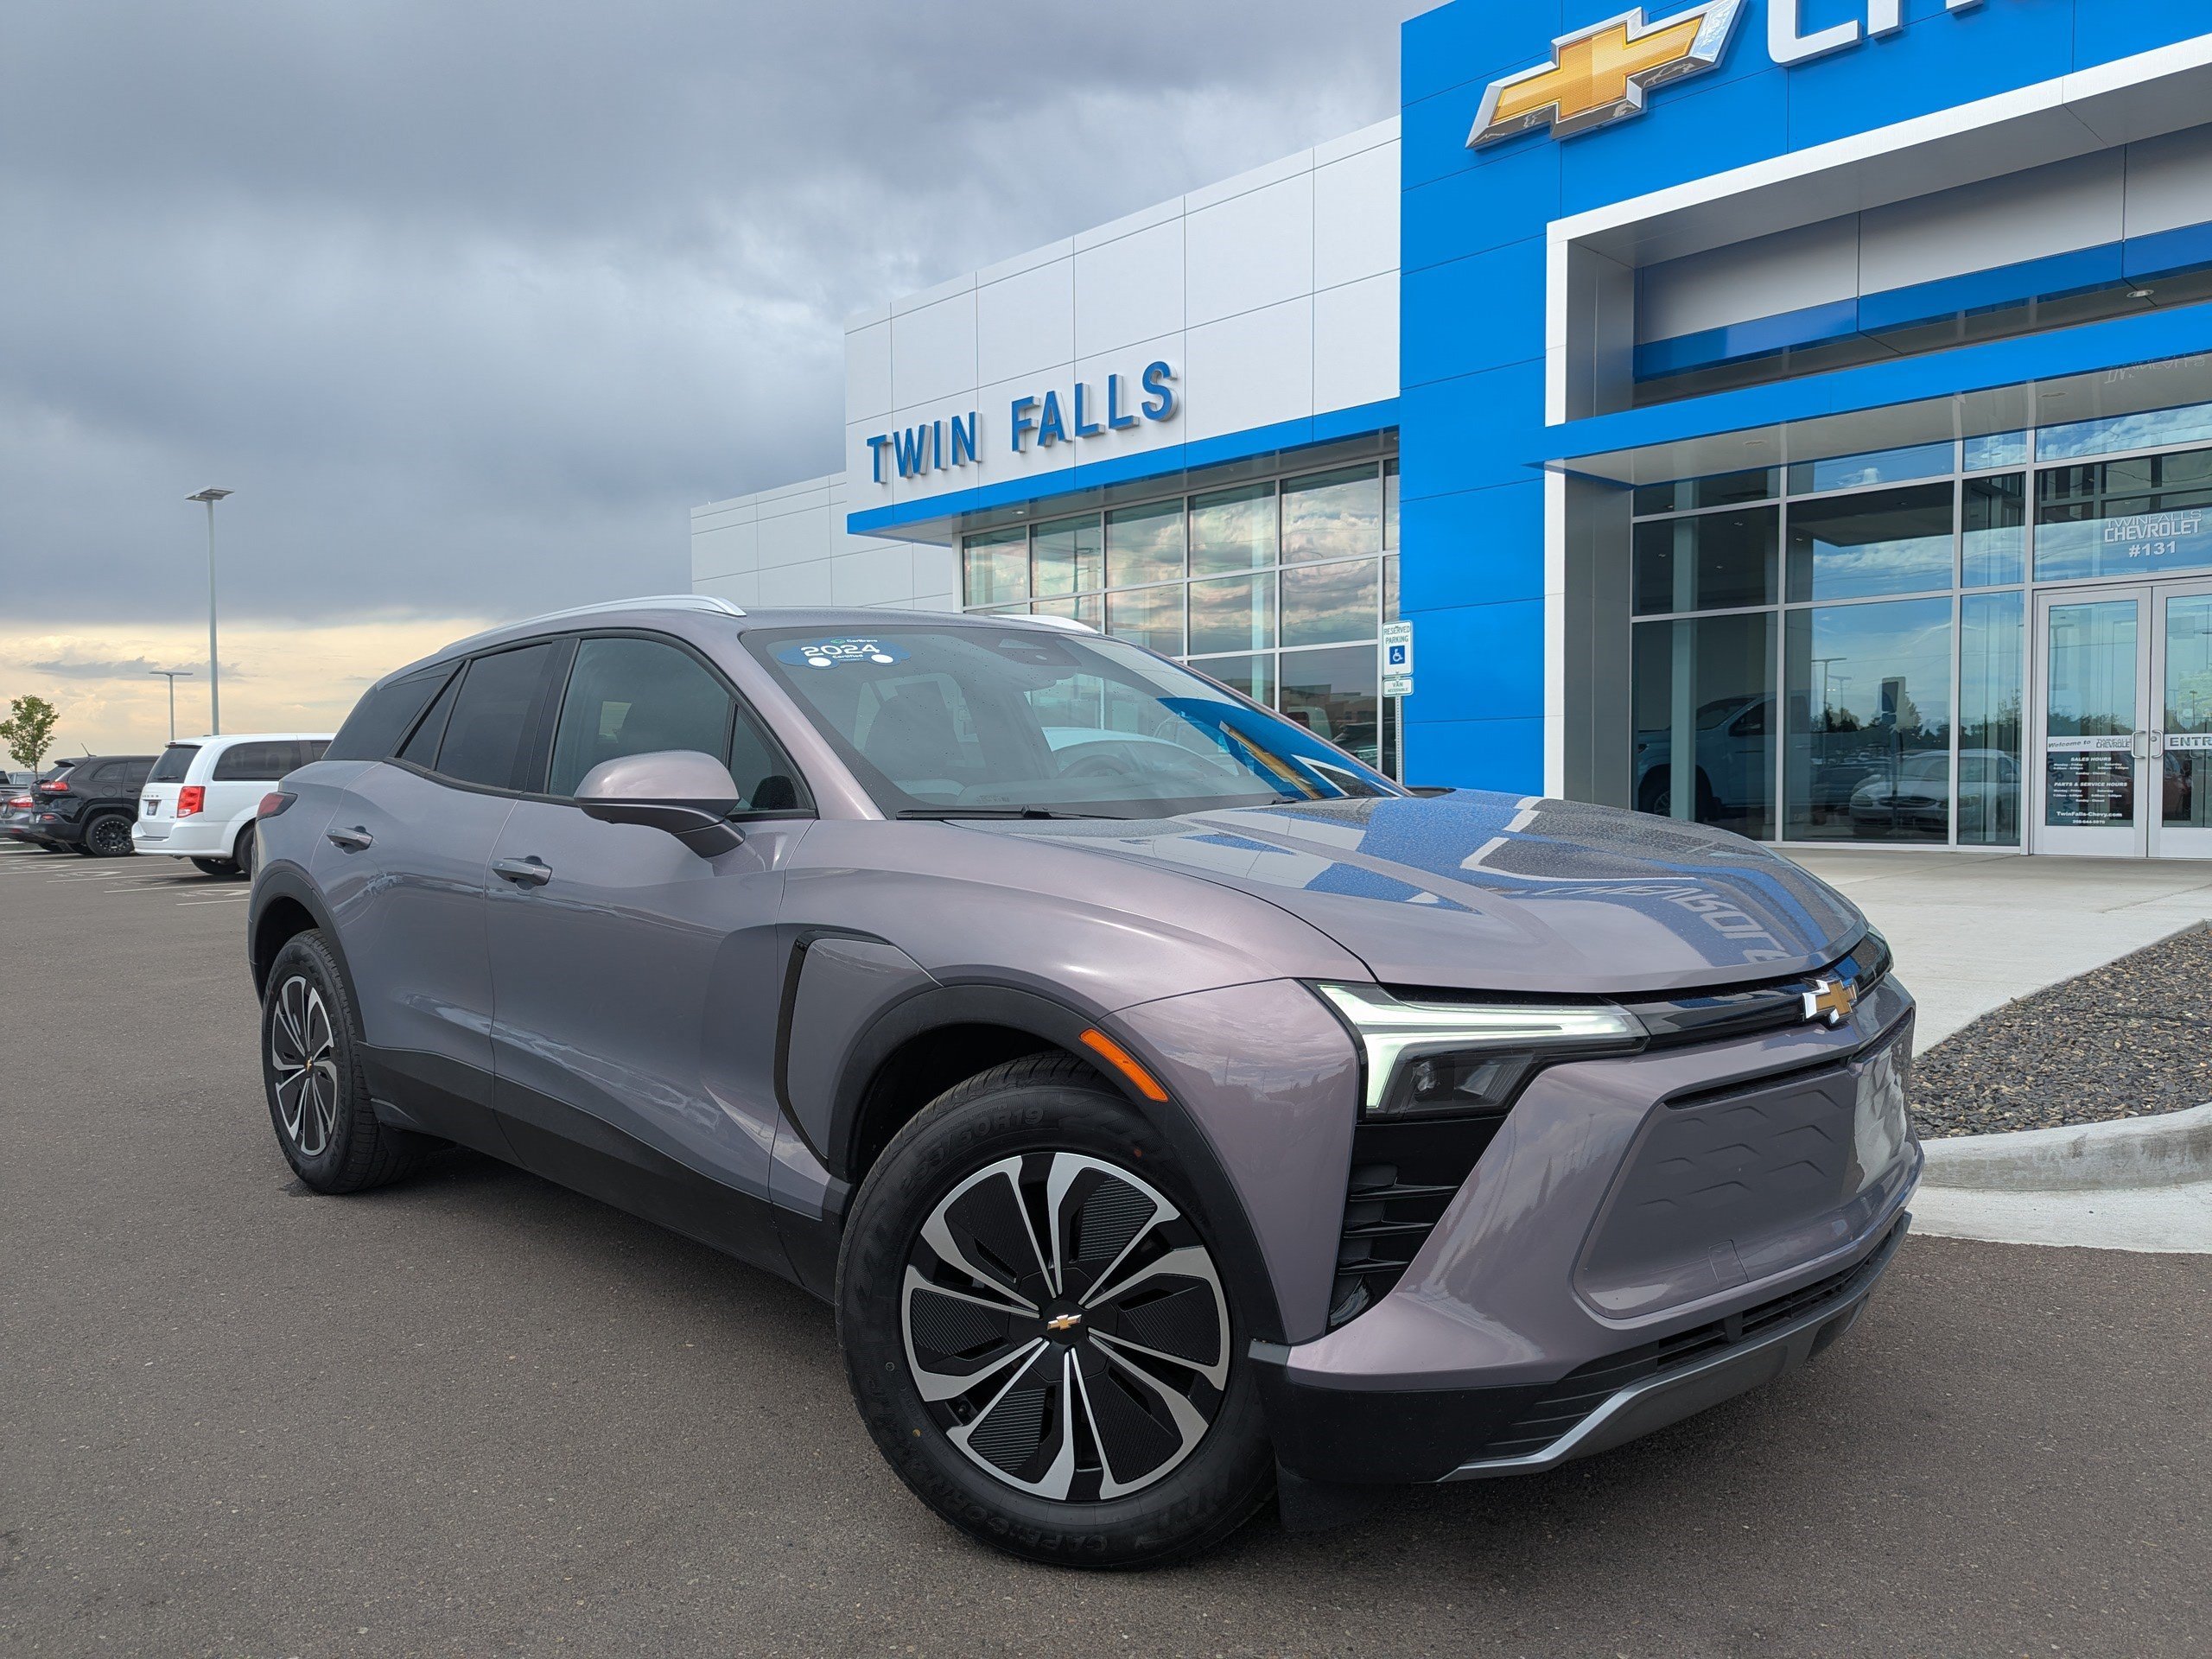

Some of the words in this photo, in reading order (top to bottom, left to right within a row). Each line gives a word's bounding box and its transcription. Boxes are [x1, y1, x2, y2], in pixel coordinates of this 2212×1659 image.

[867, 411, 982, 484] TWIN
[1011, 360, 1179, 453] FALLS
[2104, 518, 2202, 543] CHEVROLET
[2128, 540, 2176, 558] #131
[1383, 626, 1410, 635] RESERVED
[1385, 635, 1409, 645] PARKING
[801, 645, 880, 657] 2024
